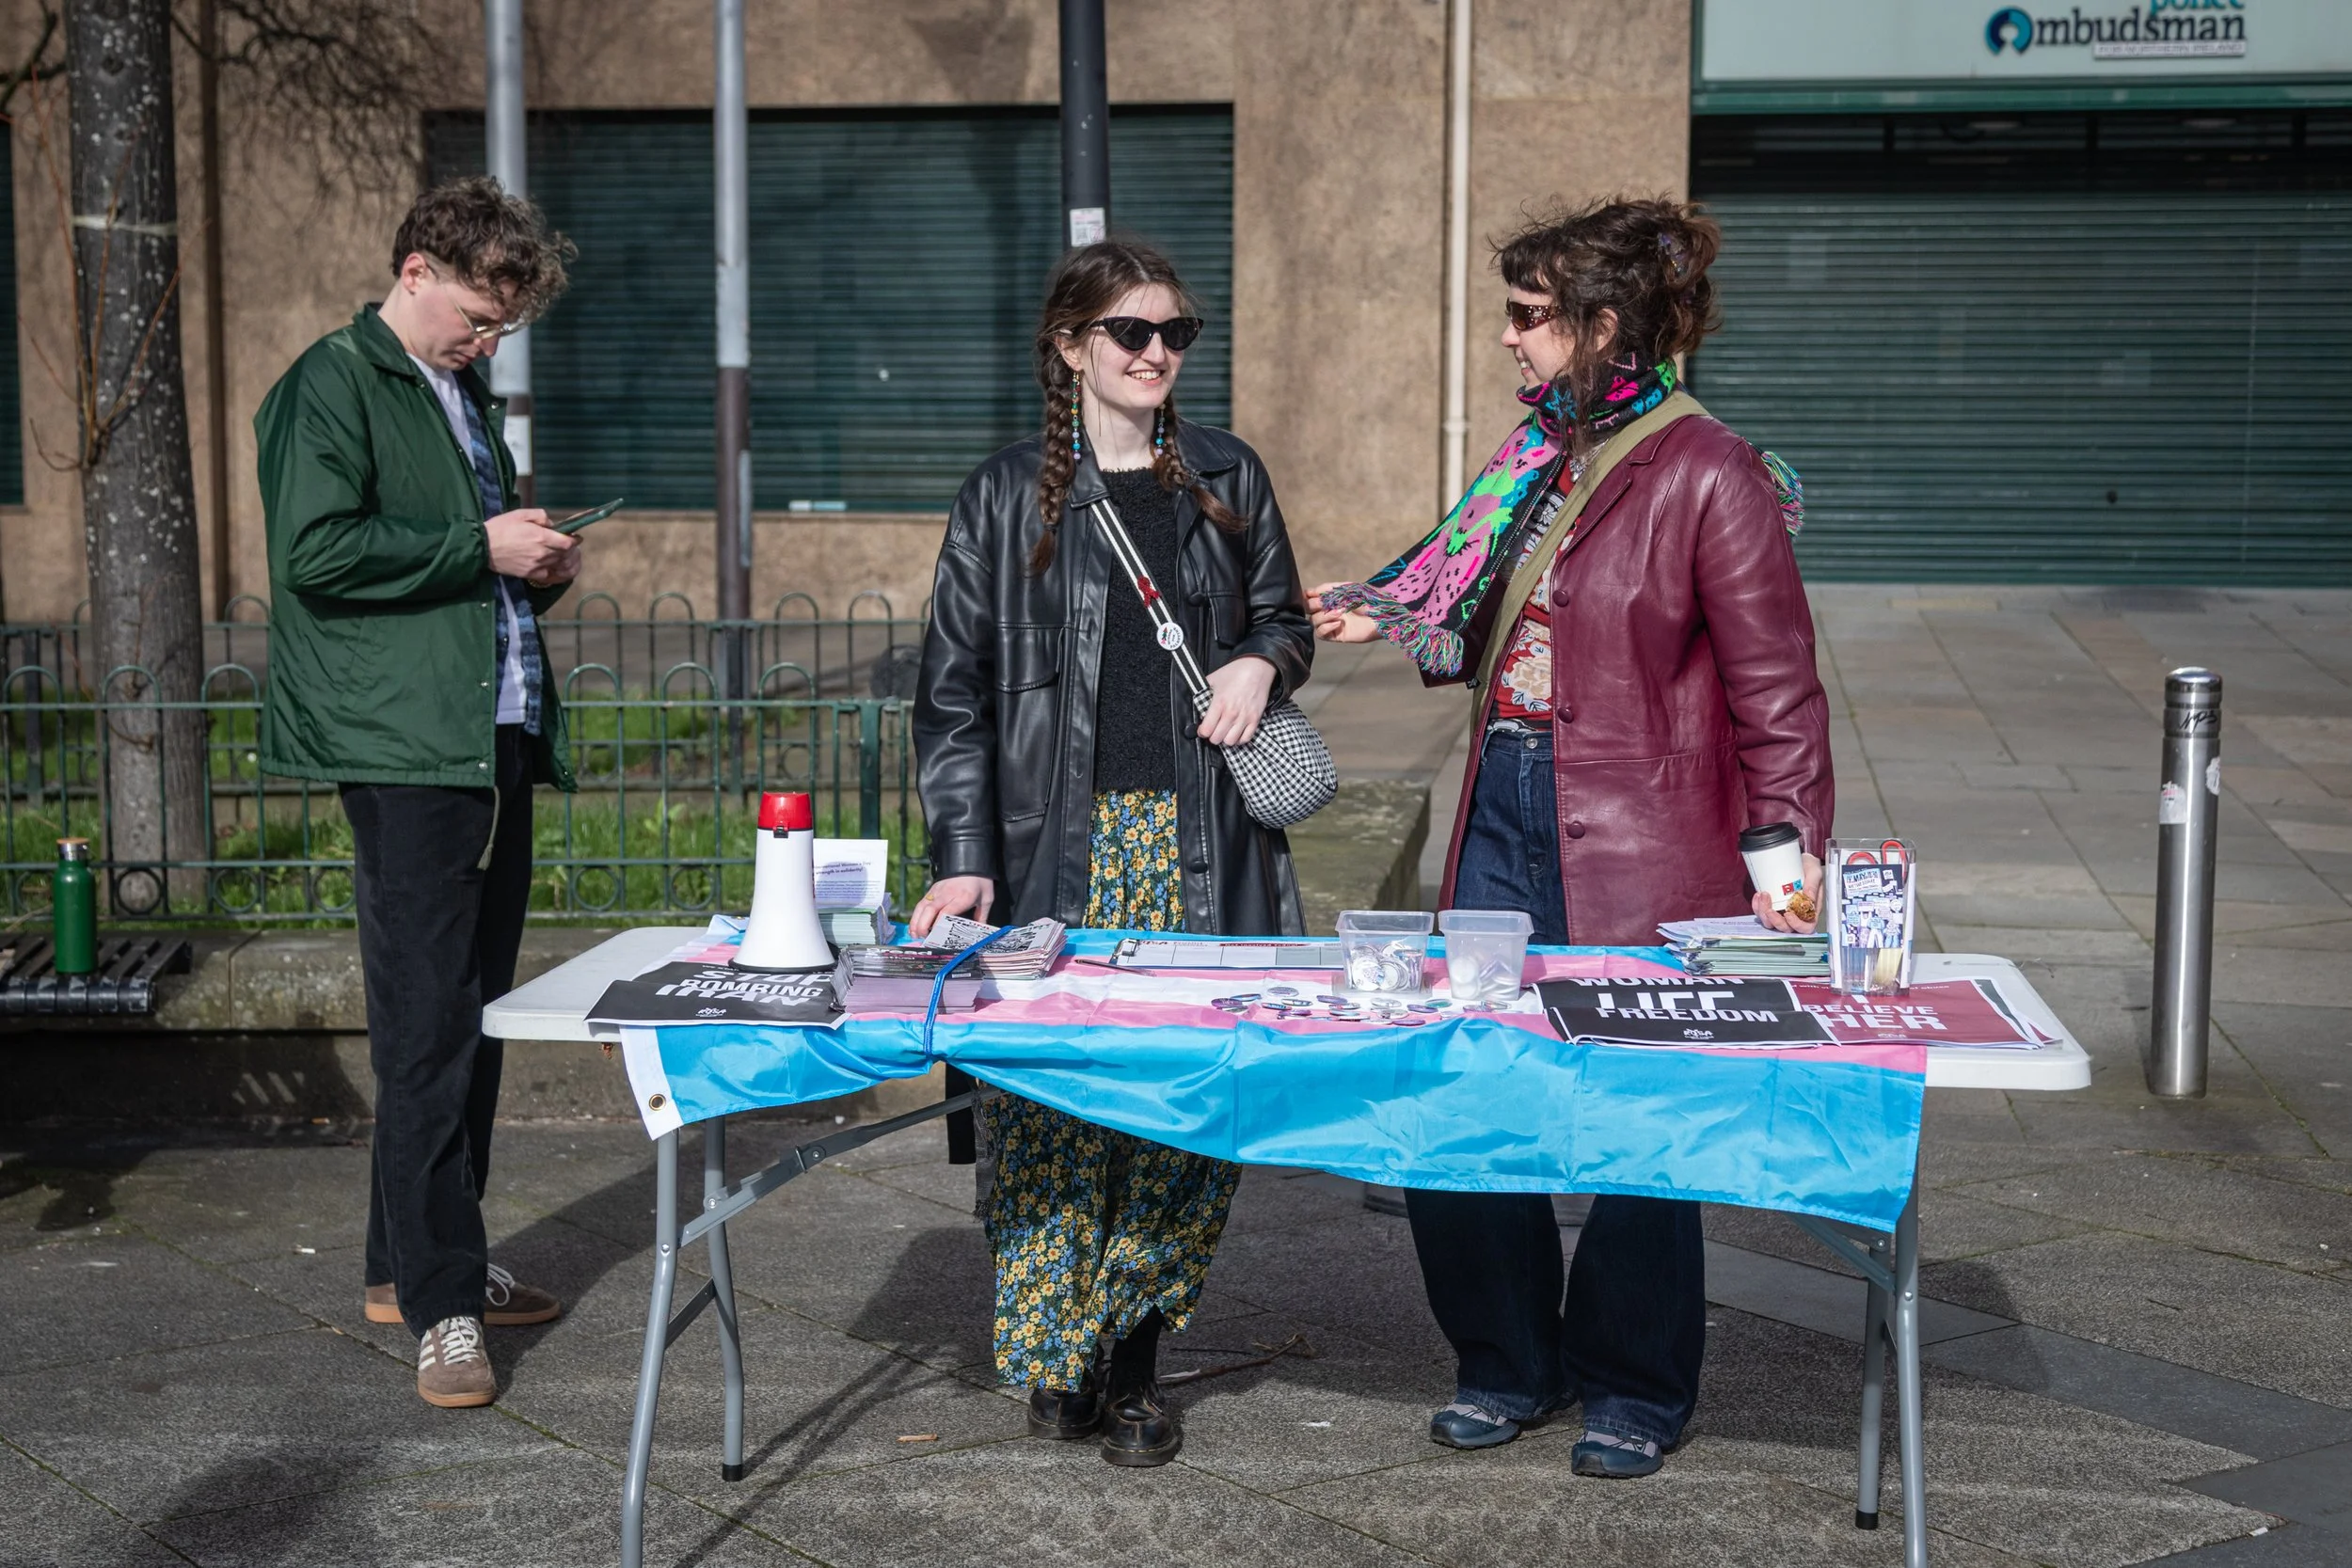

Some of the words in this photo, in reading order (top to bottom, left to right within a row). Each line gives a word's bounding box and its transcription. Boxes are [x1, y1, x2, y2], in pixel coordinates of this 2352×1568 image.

[693, 970, 834, 986] STOP
[679, 978, 824, 997] BOMBING
[1595, 1006, 1779, 1023] FREEDOM
[1801, 1004, 1939, 1016] BELIEVE
[1820, 1013, 1948, 1030] HER
